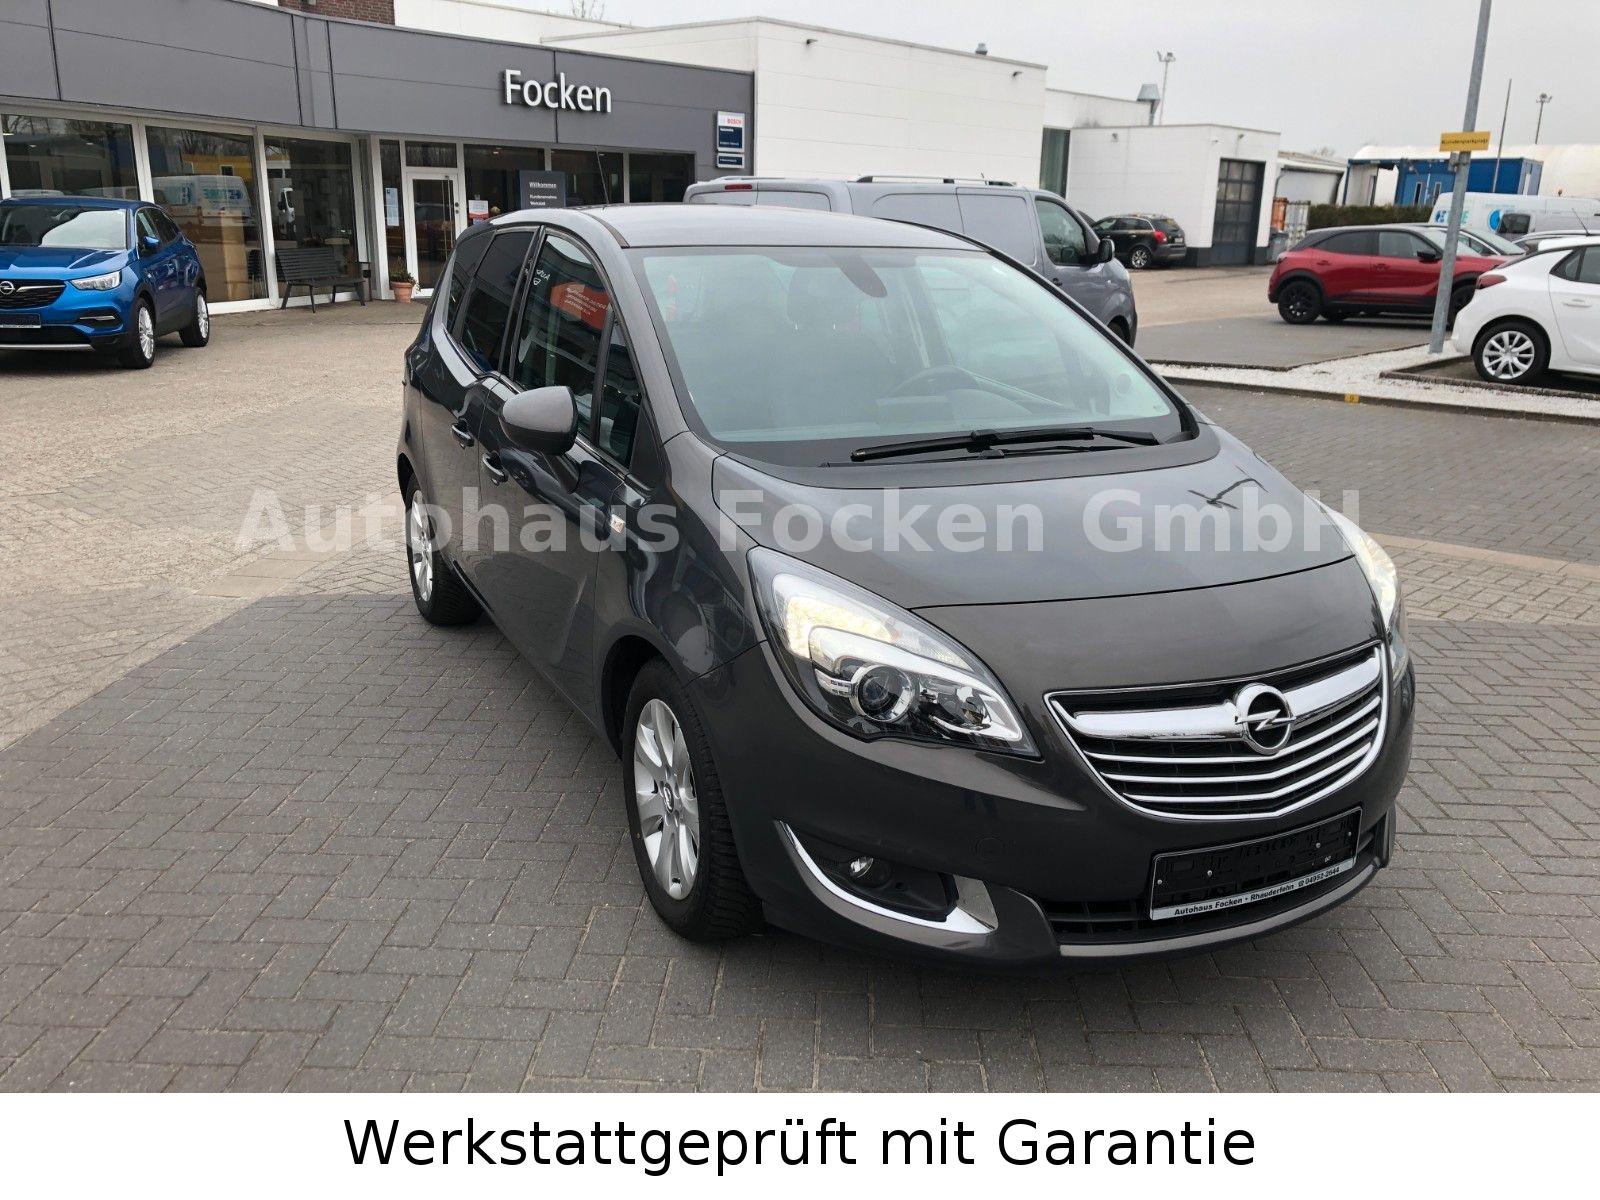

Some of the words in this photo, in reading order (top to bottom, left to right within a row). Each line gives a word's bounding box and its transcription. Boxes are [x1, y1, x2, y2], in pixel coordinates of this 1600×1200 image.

[505, 69, 611, 112] Focken
[1174, 902, 1213, 917] Autohaus
[1214, 897, 1243, 909] Focken
[1250, 883, 1295, 901] Rhauderfehn
